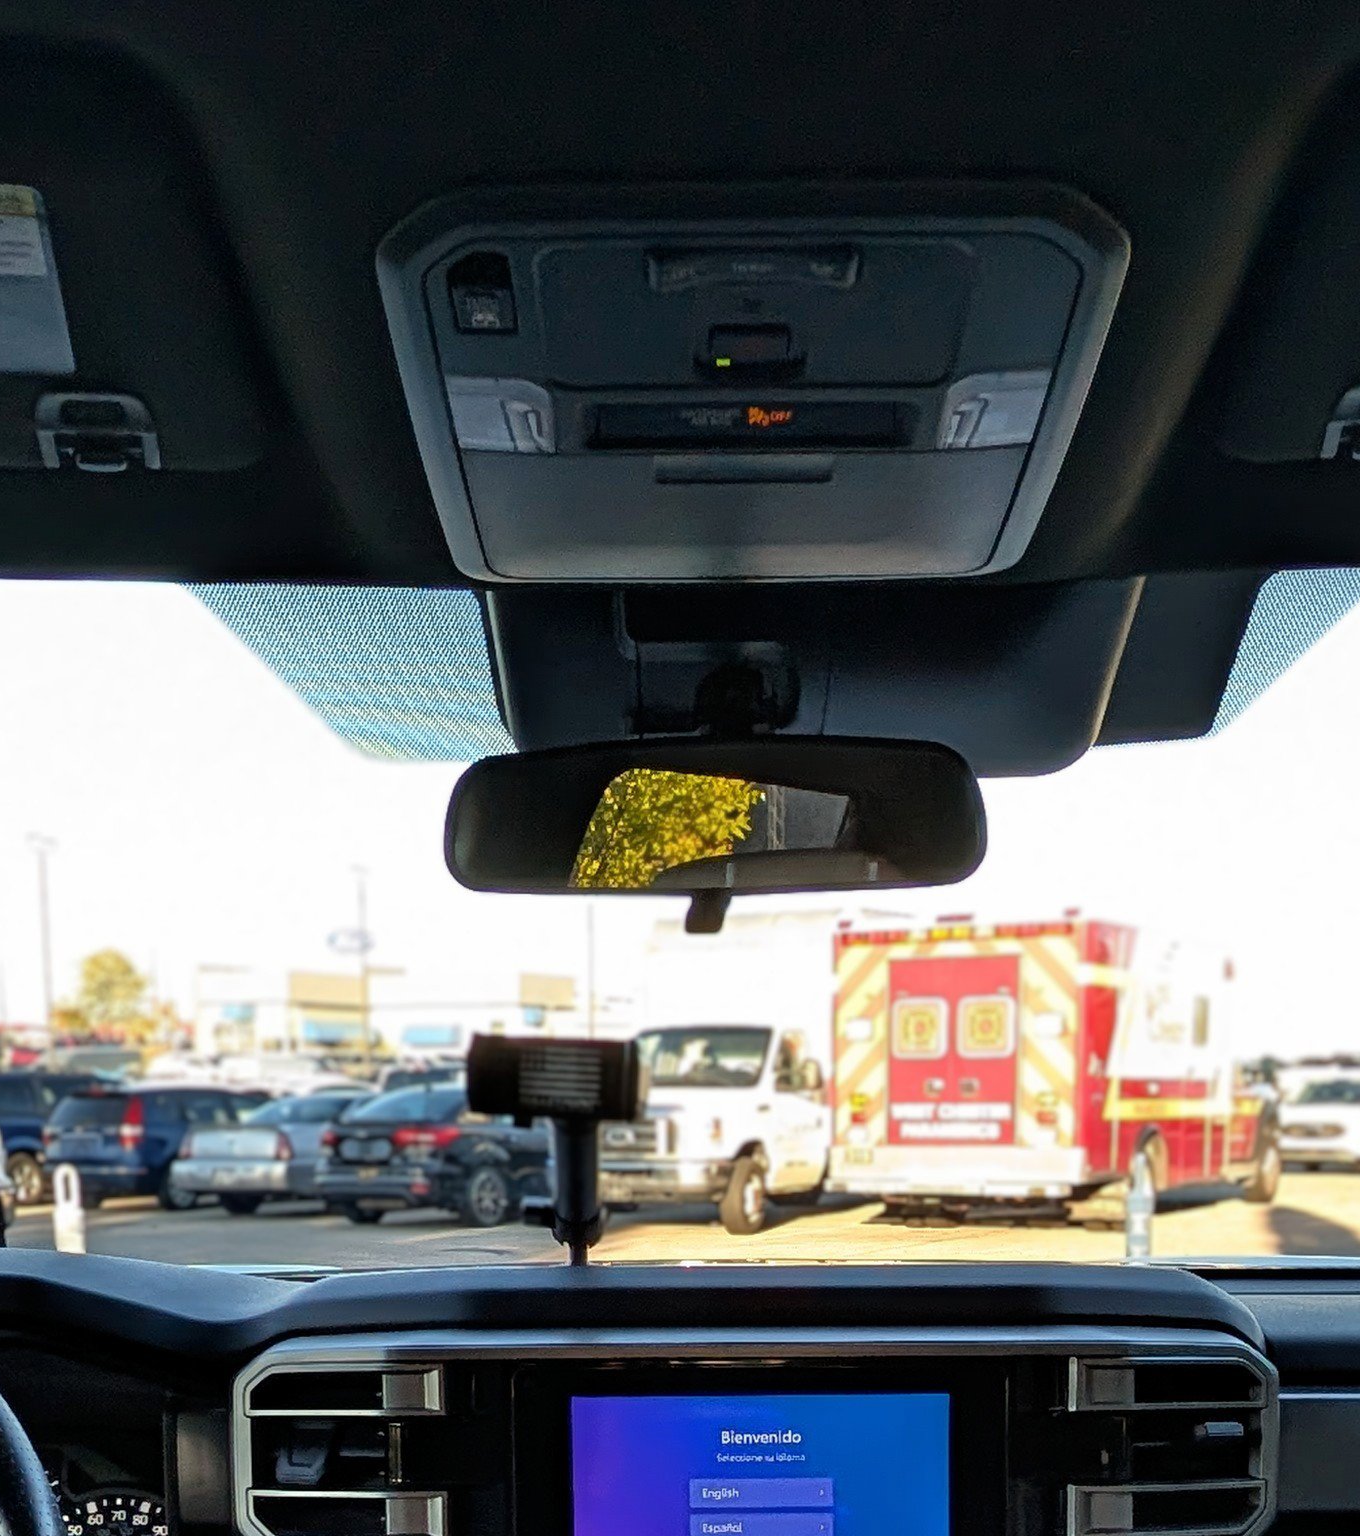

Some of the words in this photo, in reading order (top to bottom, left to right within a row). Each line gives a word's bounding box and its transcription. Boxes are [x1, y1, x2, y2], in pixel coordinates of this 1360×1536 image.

[720, 1430, 802, 1446] Bienvenido
[702, 1488, 739, 1501] English
[86, 1514, 104, 1526] 60
[111, 1510, 127, 1521] 70
[132, 1514, 149, 1526] 80
[67, 1525, 83, 1536] 50
[151, 1525, 169, 1536] 90
[702, 1522, 743, 1535] Español
